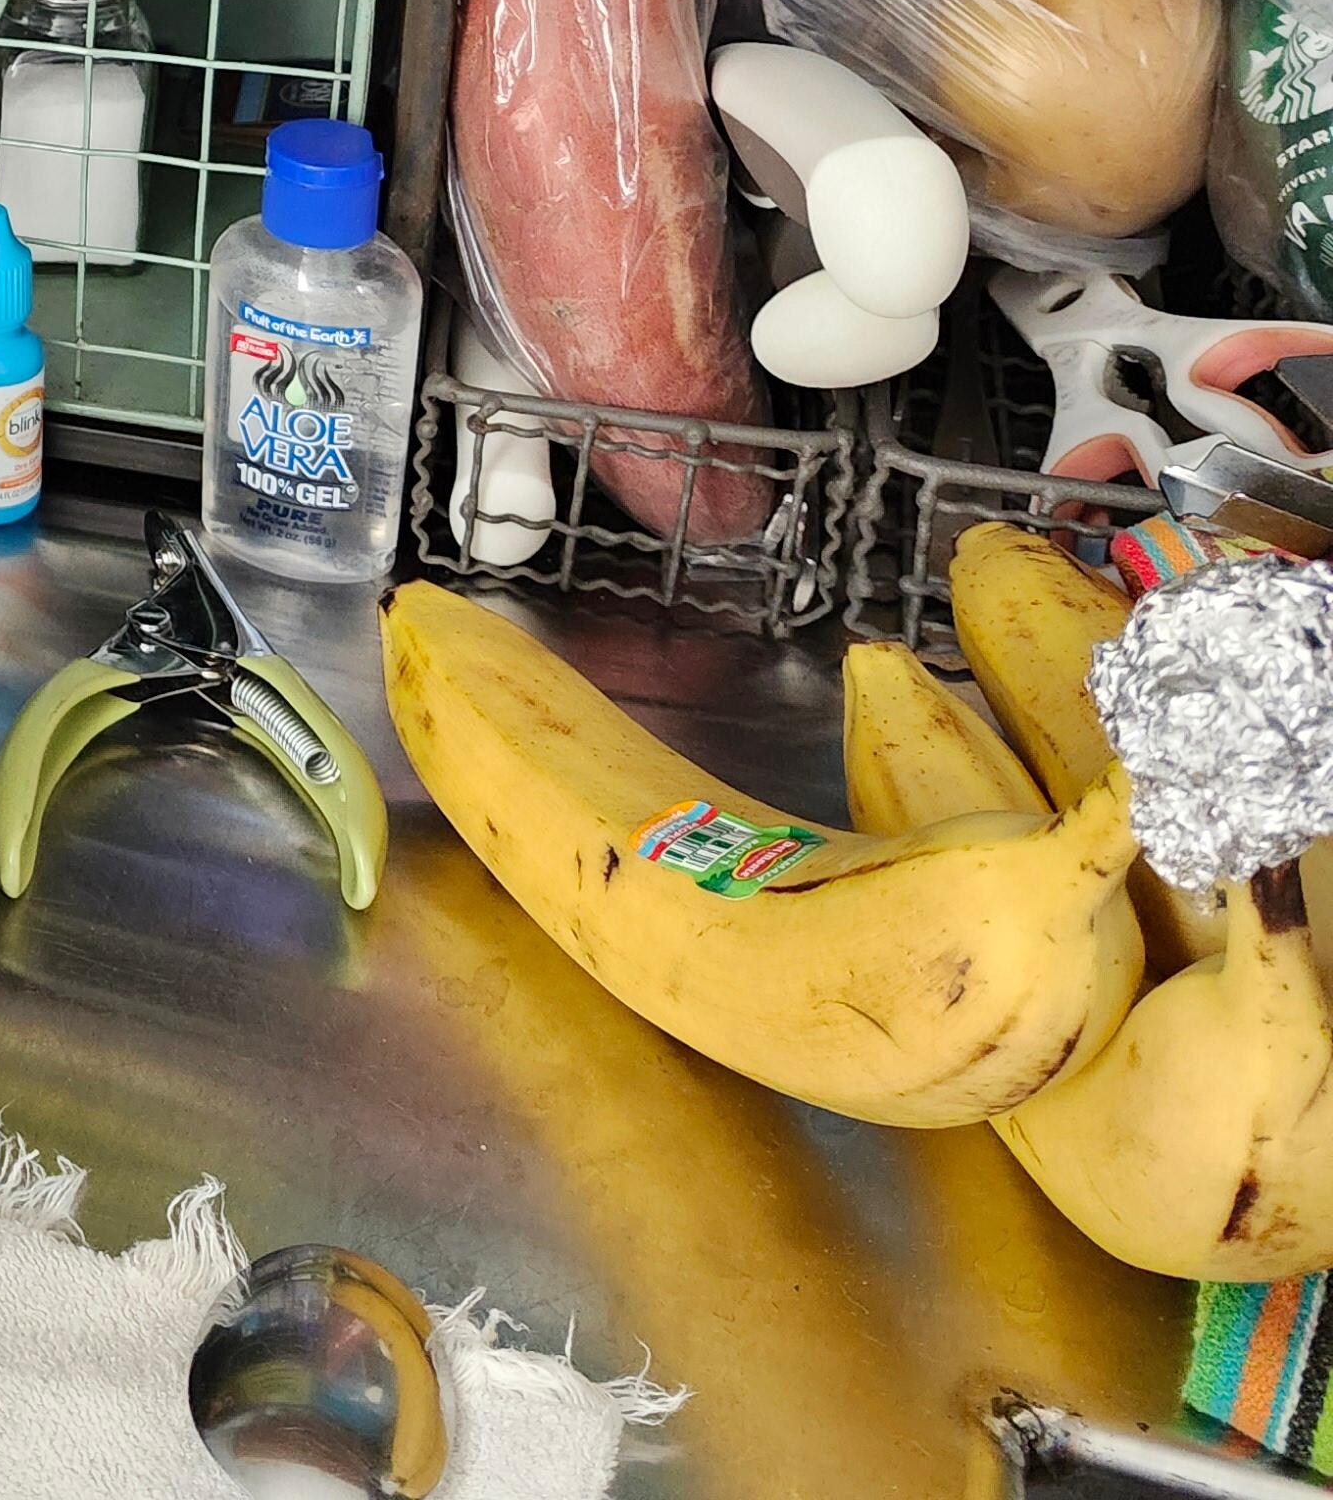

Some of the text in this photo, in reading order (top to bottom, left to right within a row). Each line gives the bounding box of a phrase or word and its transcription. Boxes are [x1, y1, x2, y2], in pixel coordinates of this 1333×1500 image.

[244, 305, 350, 347] Fruit of the Earth
[8, 409, 42, 436] blink
[239, 395, 354, 449] ALOE
[238, 420, 354, 483] VERA
[237, 463, 295, 497] 100%
[256, 497, 325, 525] PURE
